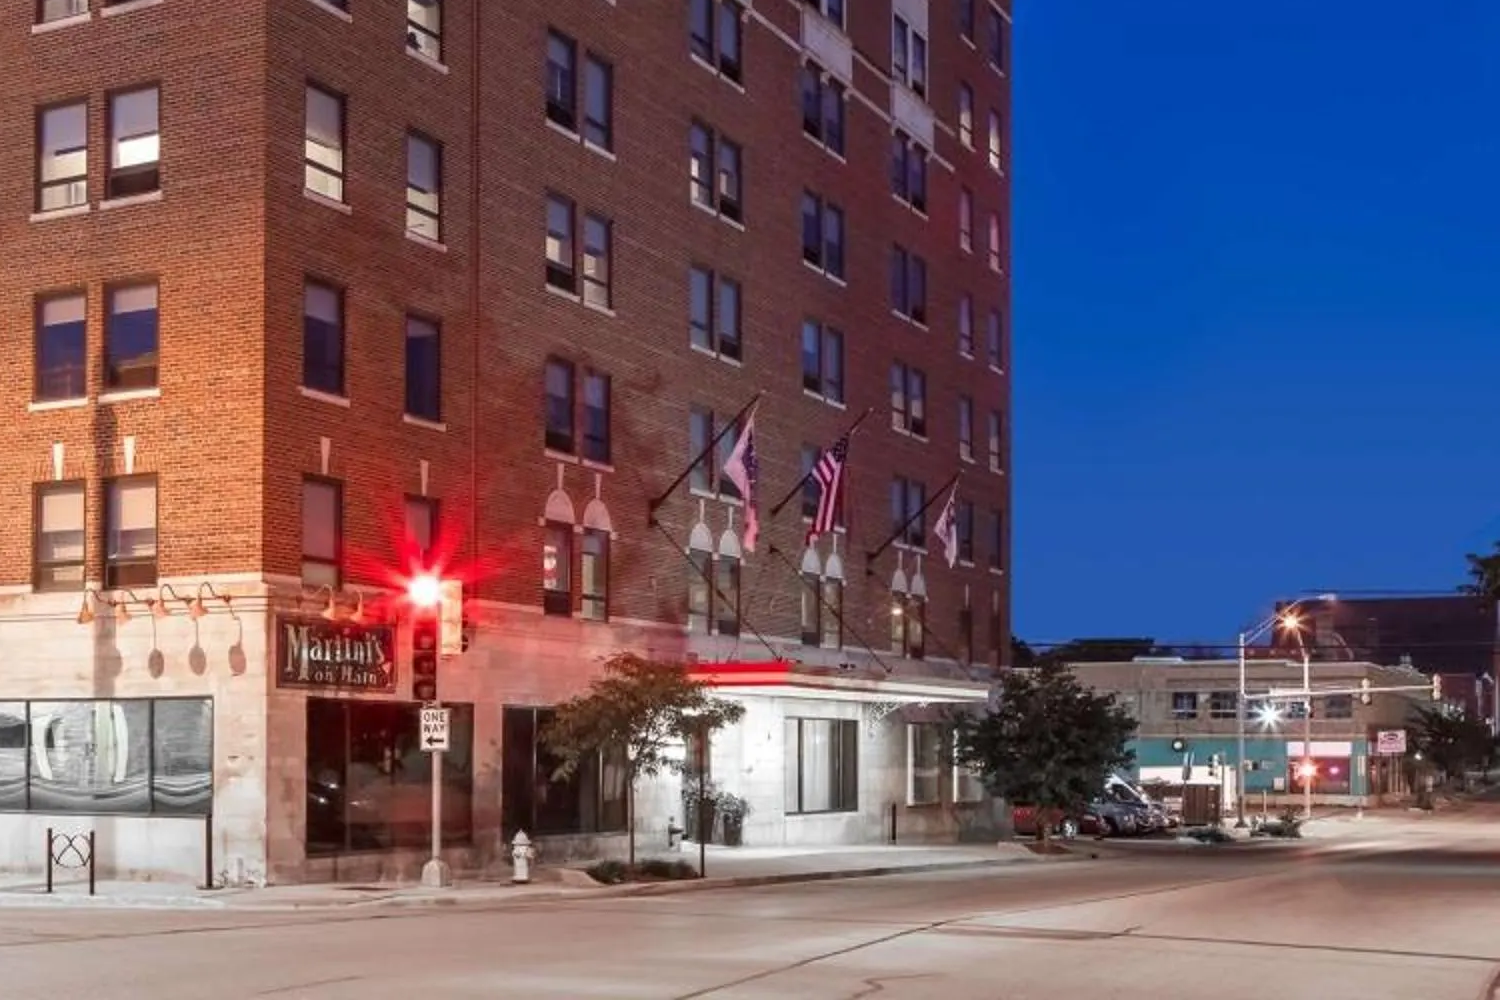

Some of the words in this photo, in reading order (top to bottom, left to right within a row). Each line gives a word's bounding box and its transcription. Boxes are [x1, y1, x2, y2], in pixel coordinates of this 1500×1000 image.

[283, 623, 385, 680] Martini's
[314, 667, 333, 682] on
[341, 665, 377, 685] Main
[423, 711, 445, 723] ONE
[423, 723, 445, 733] WAY
